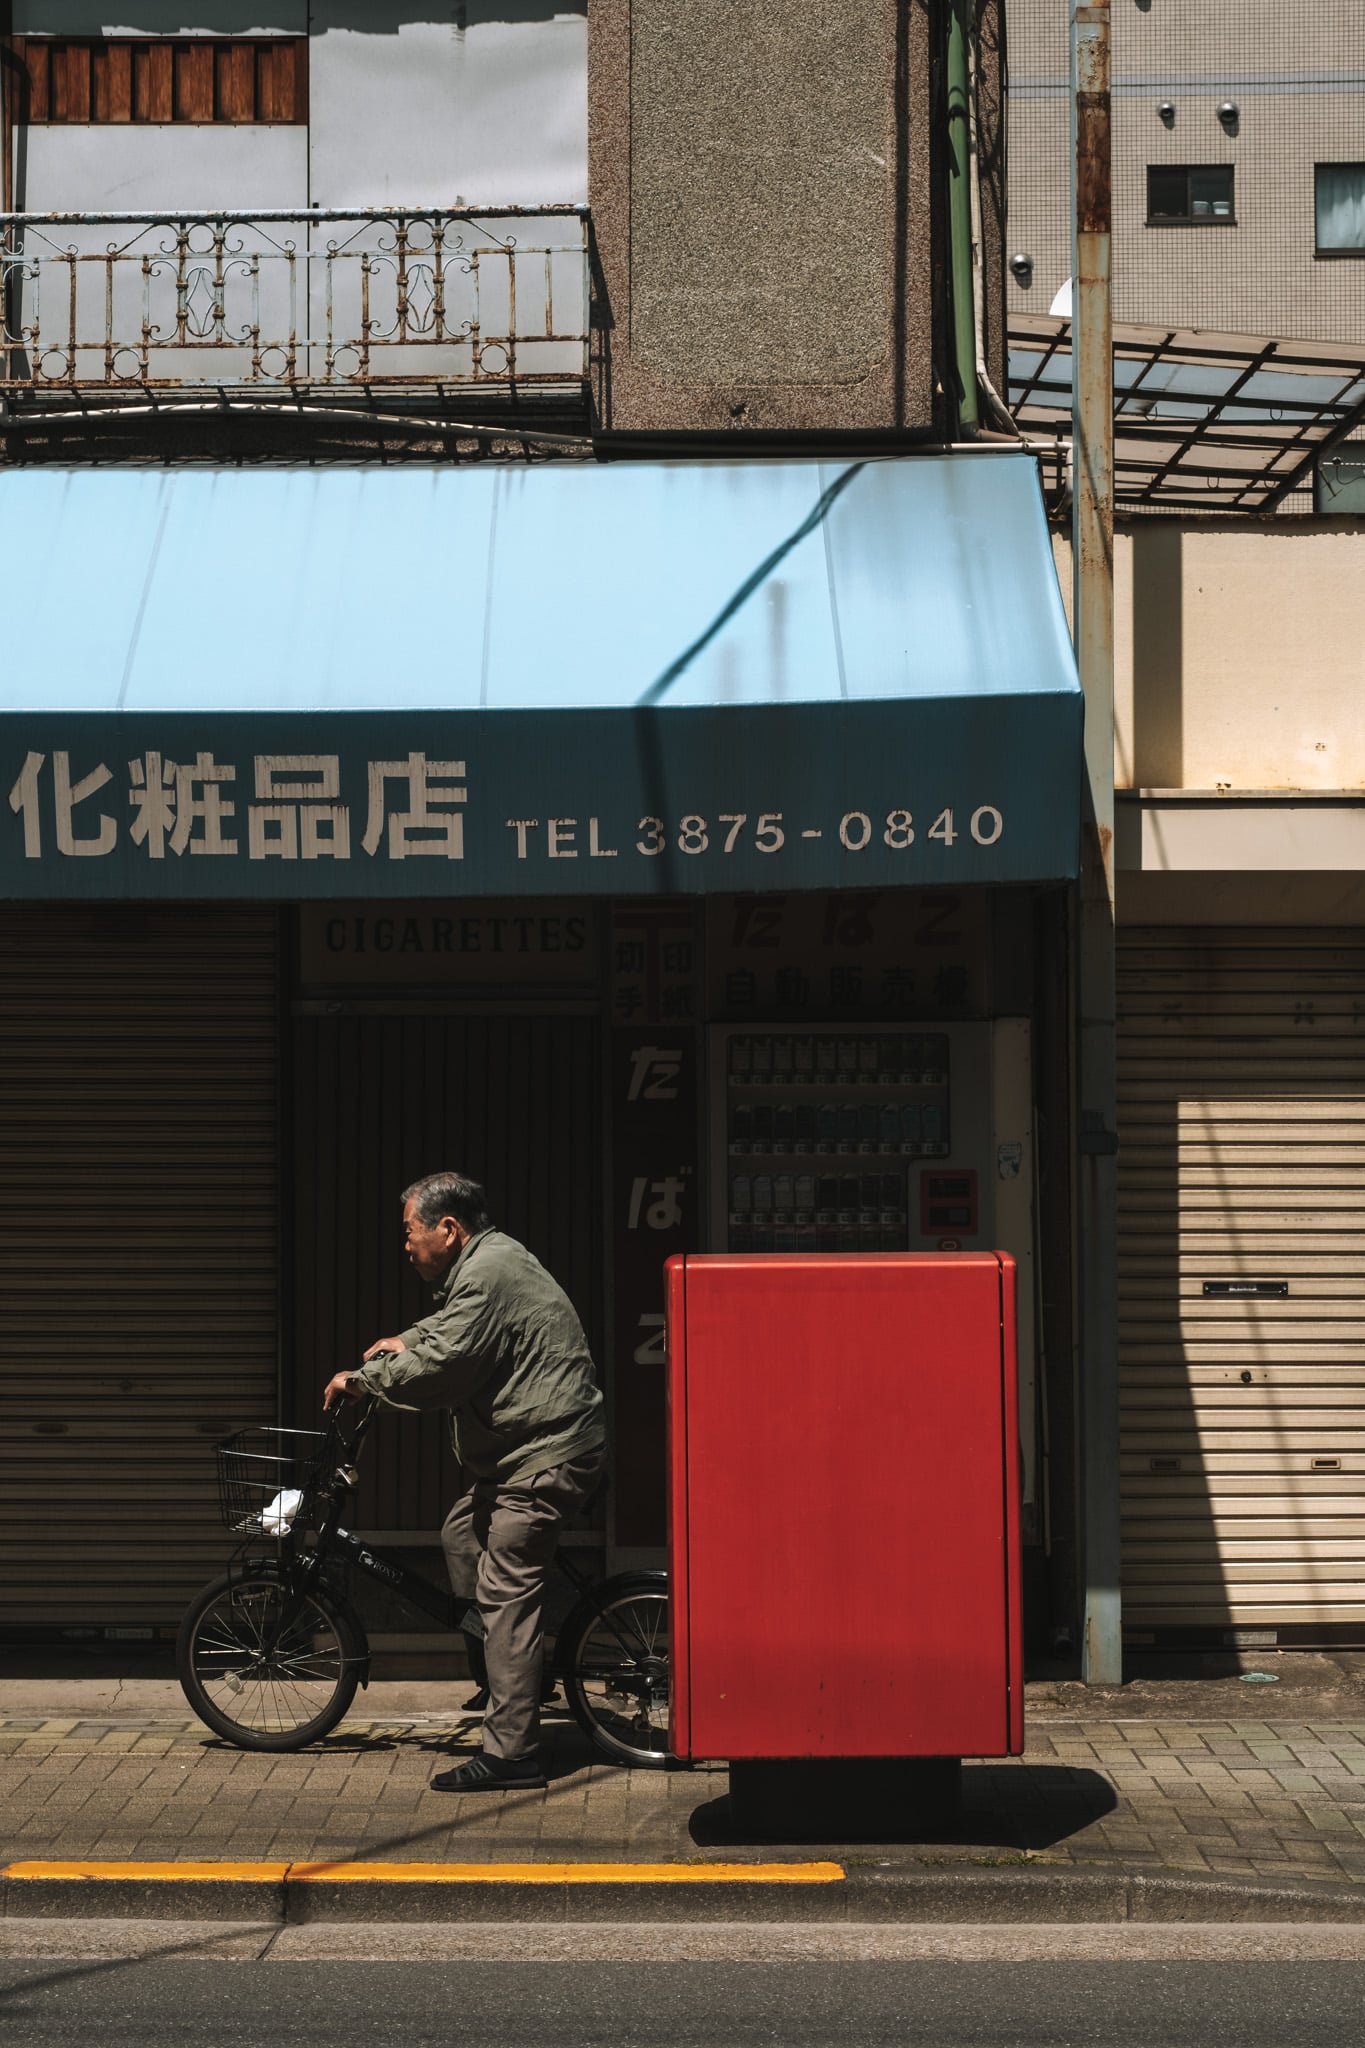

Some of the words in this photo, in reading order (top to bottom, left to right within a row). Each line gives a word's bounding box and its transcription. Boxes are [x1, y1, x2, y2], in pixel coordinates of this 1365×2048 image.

[8, 751, 468, 860] 化粧品店
[505, 816, 618, 859] TEL
[635, 804, 1004, 856] 3875-0840
[325, 916, 586, 953] CIGARETTES
